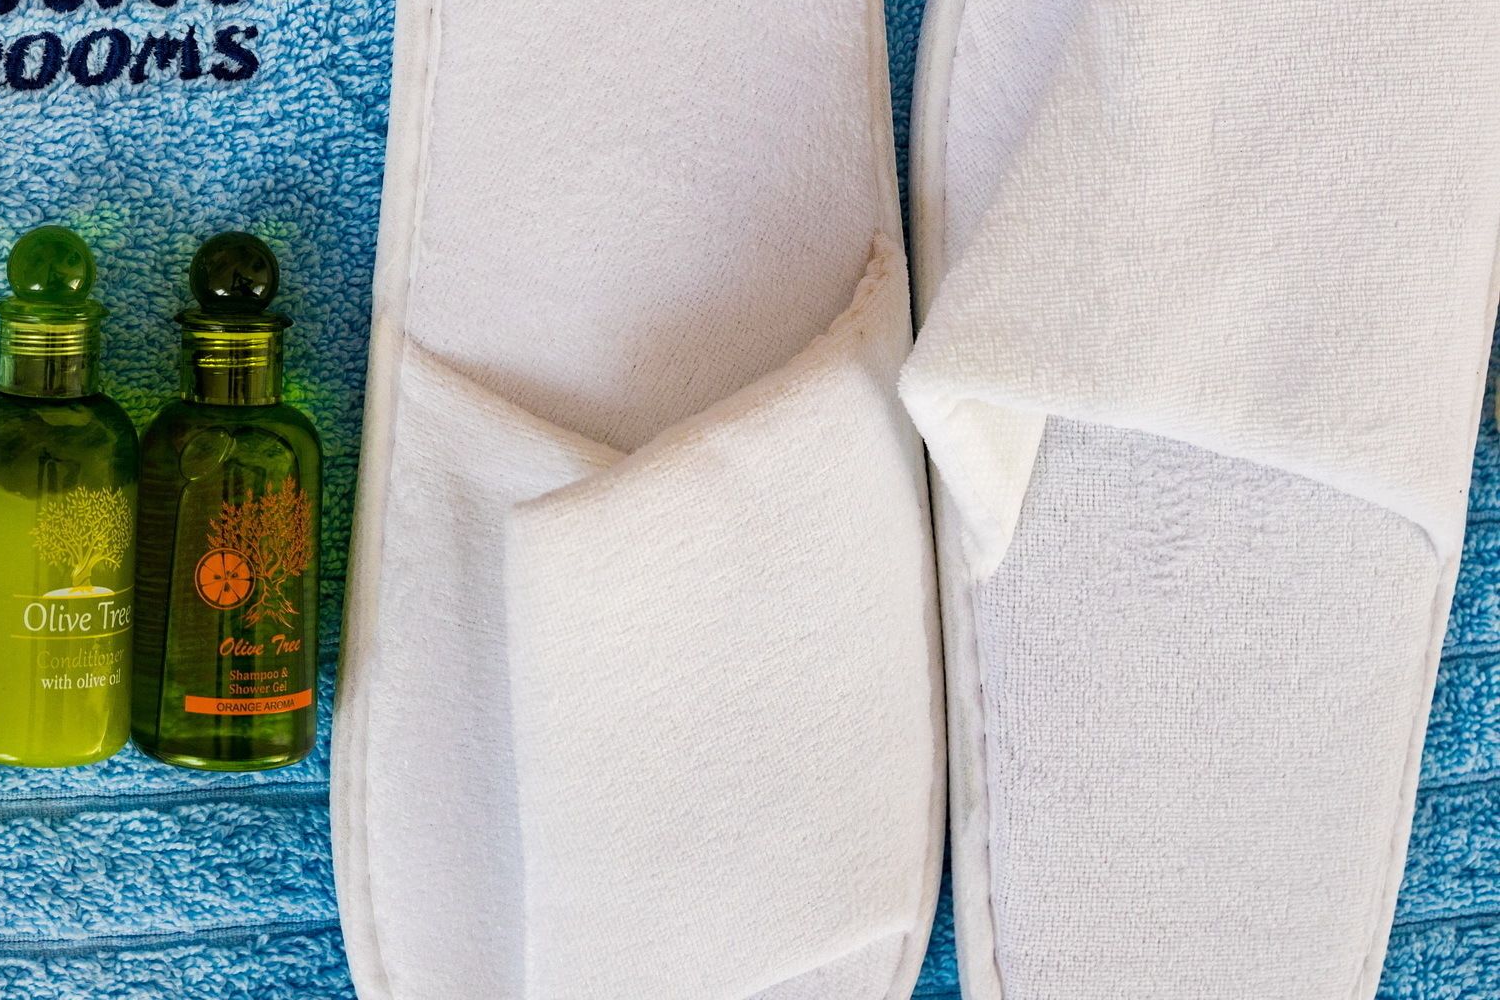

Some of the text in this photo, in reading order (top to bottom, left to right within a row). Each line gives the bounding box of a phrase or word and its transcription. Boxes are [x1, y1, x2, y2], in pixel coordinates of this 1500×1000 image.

[23, 601, 132, 632] Olive Tree
[220, 634, 300, 656] Olive Tree
[37, 648, 124, 669] Conditioner
[41, 668, 121, 690] with olive oil
[229, 670, 279, 682] Shampoo
[229, 681, 287, 694] Shower Gel
[217, 699, 295, 712] ORANGE AROMA
